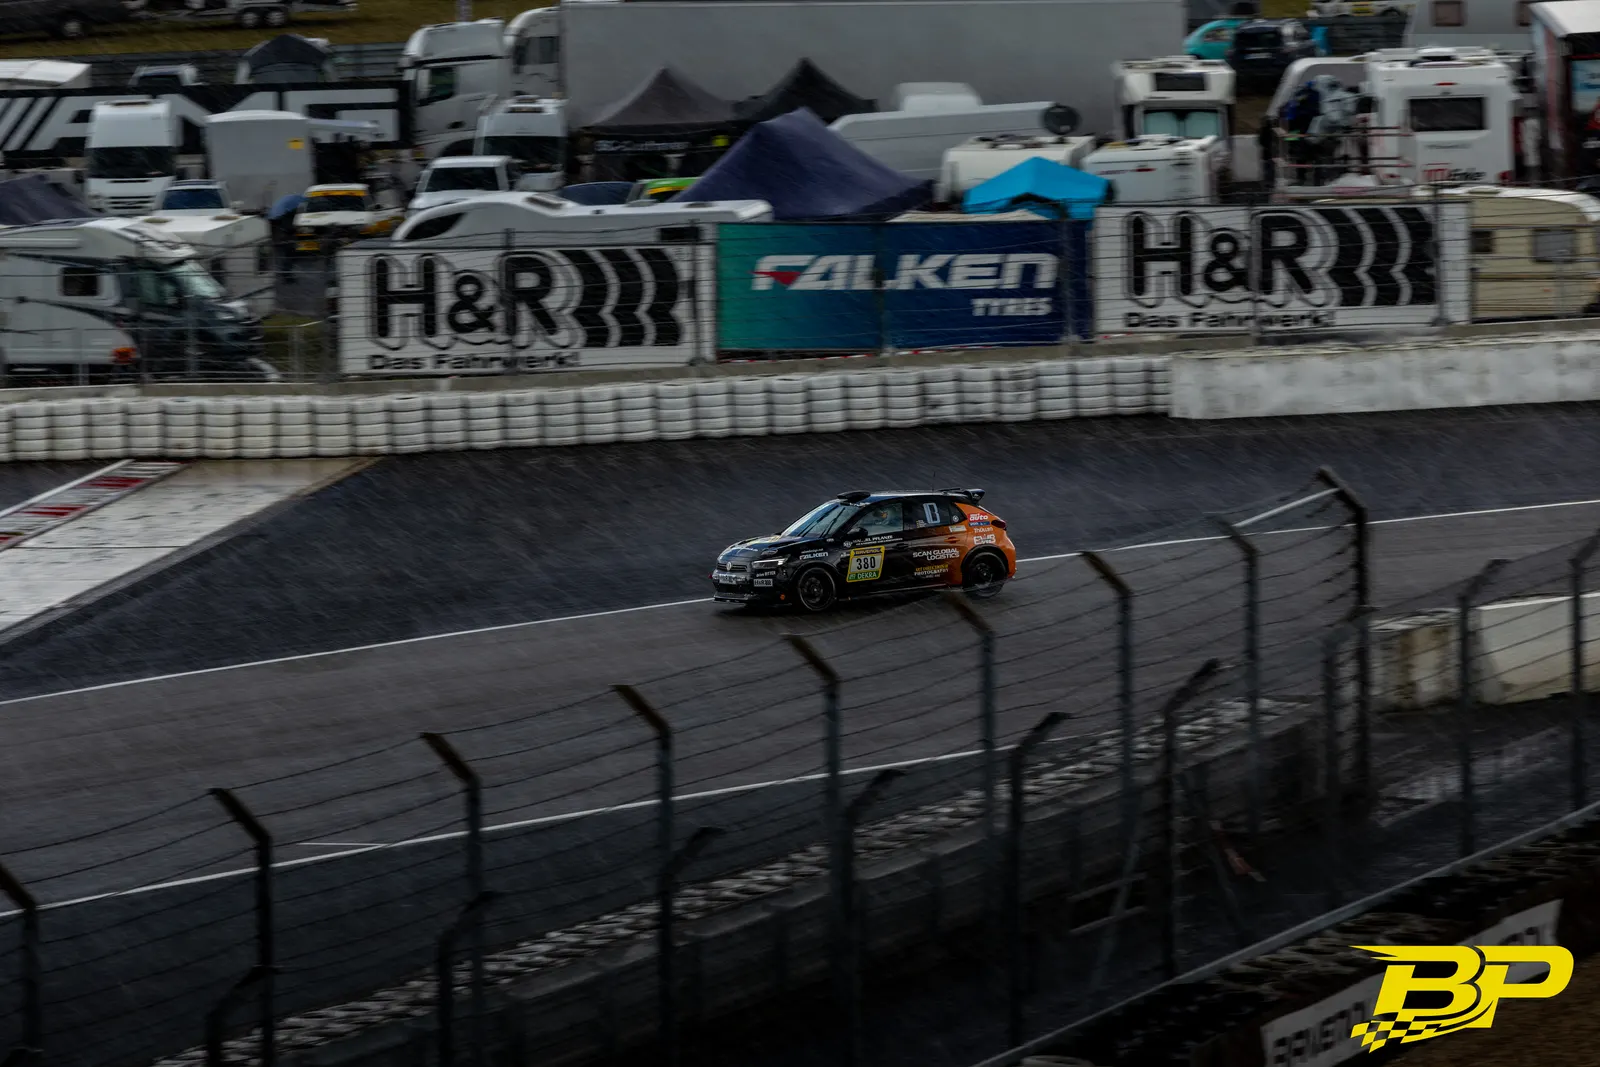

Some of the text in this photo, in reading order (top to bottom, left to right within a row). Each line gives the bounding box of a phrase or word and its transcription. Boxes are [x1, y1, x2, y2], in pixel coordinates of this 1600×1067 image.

[1126, 212, 1330, 302] H&R
[749, 252, 1058, 291] FALKEN
[370, 253, 574, 343] H&R
[1125, 312, 1179, 328] Das
[369, 354, 418, 370] Das
[912, 550, 932, 558] SCAN
[926, 551, 960, 561] LOGISTICS
[856, 556, 876, 570] 380
